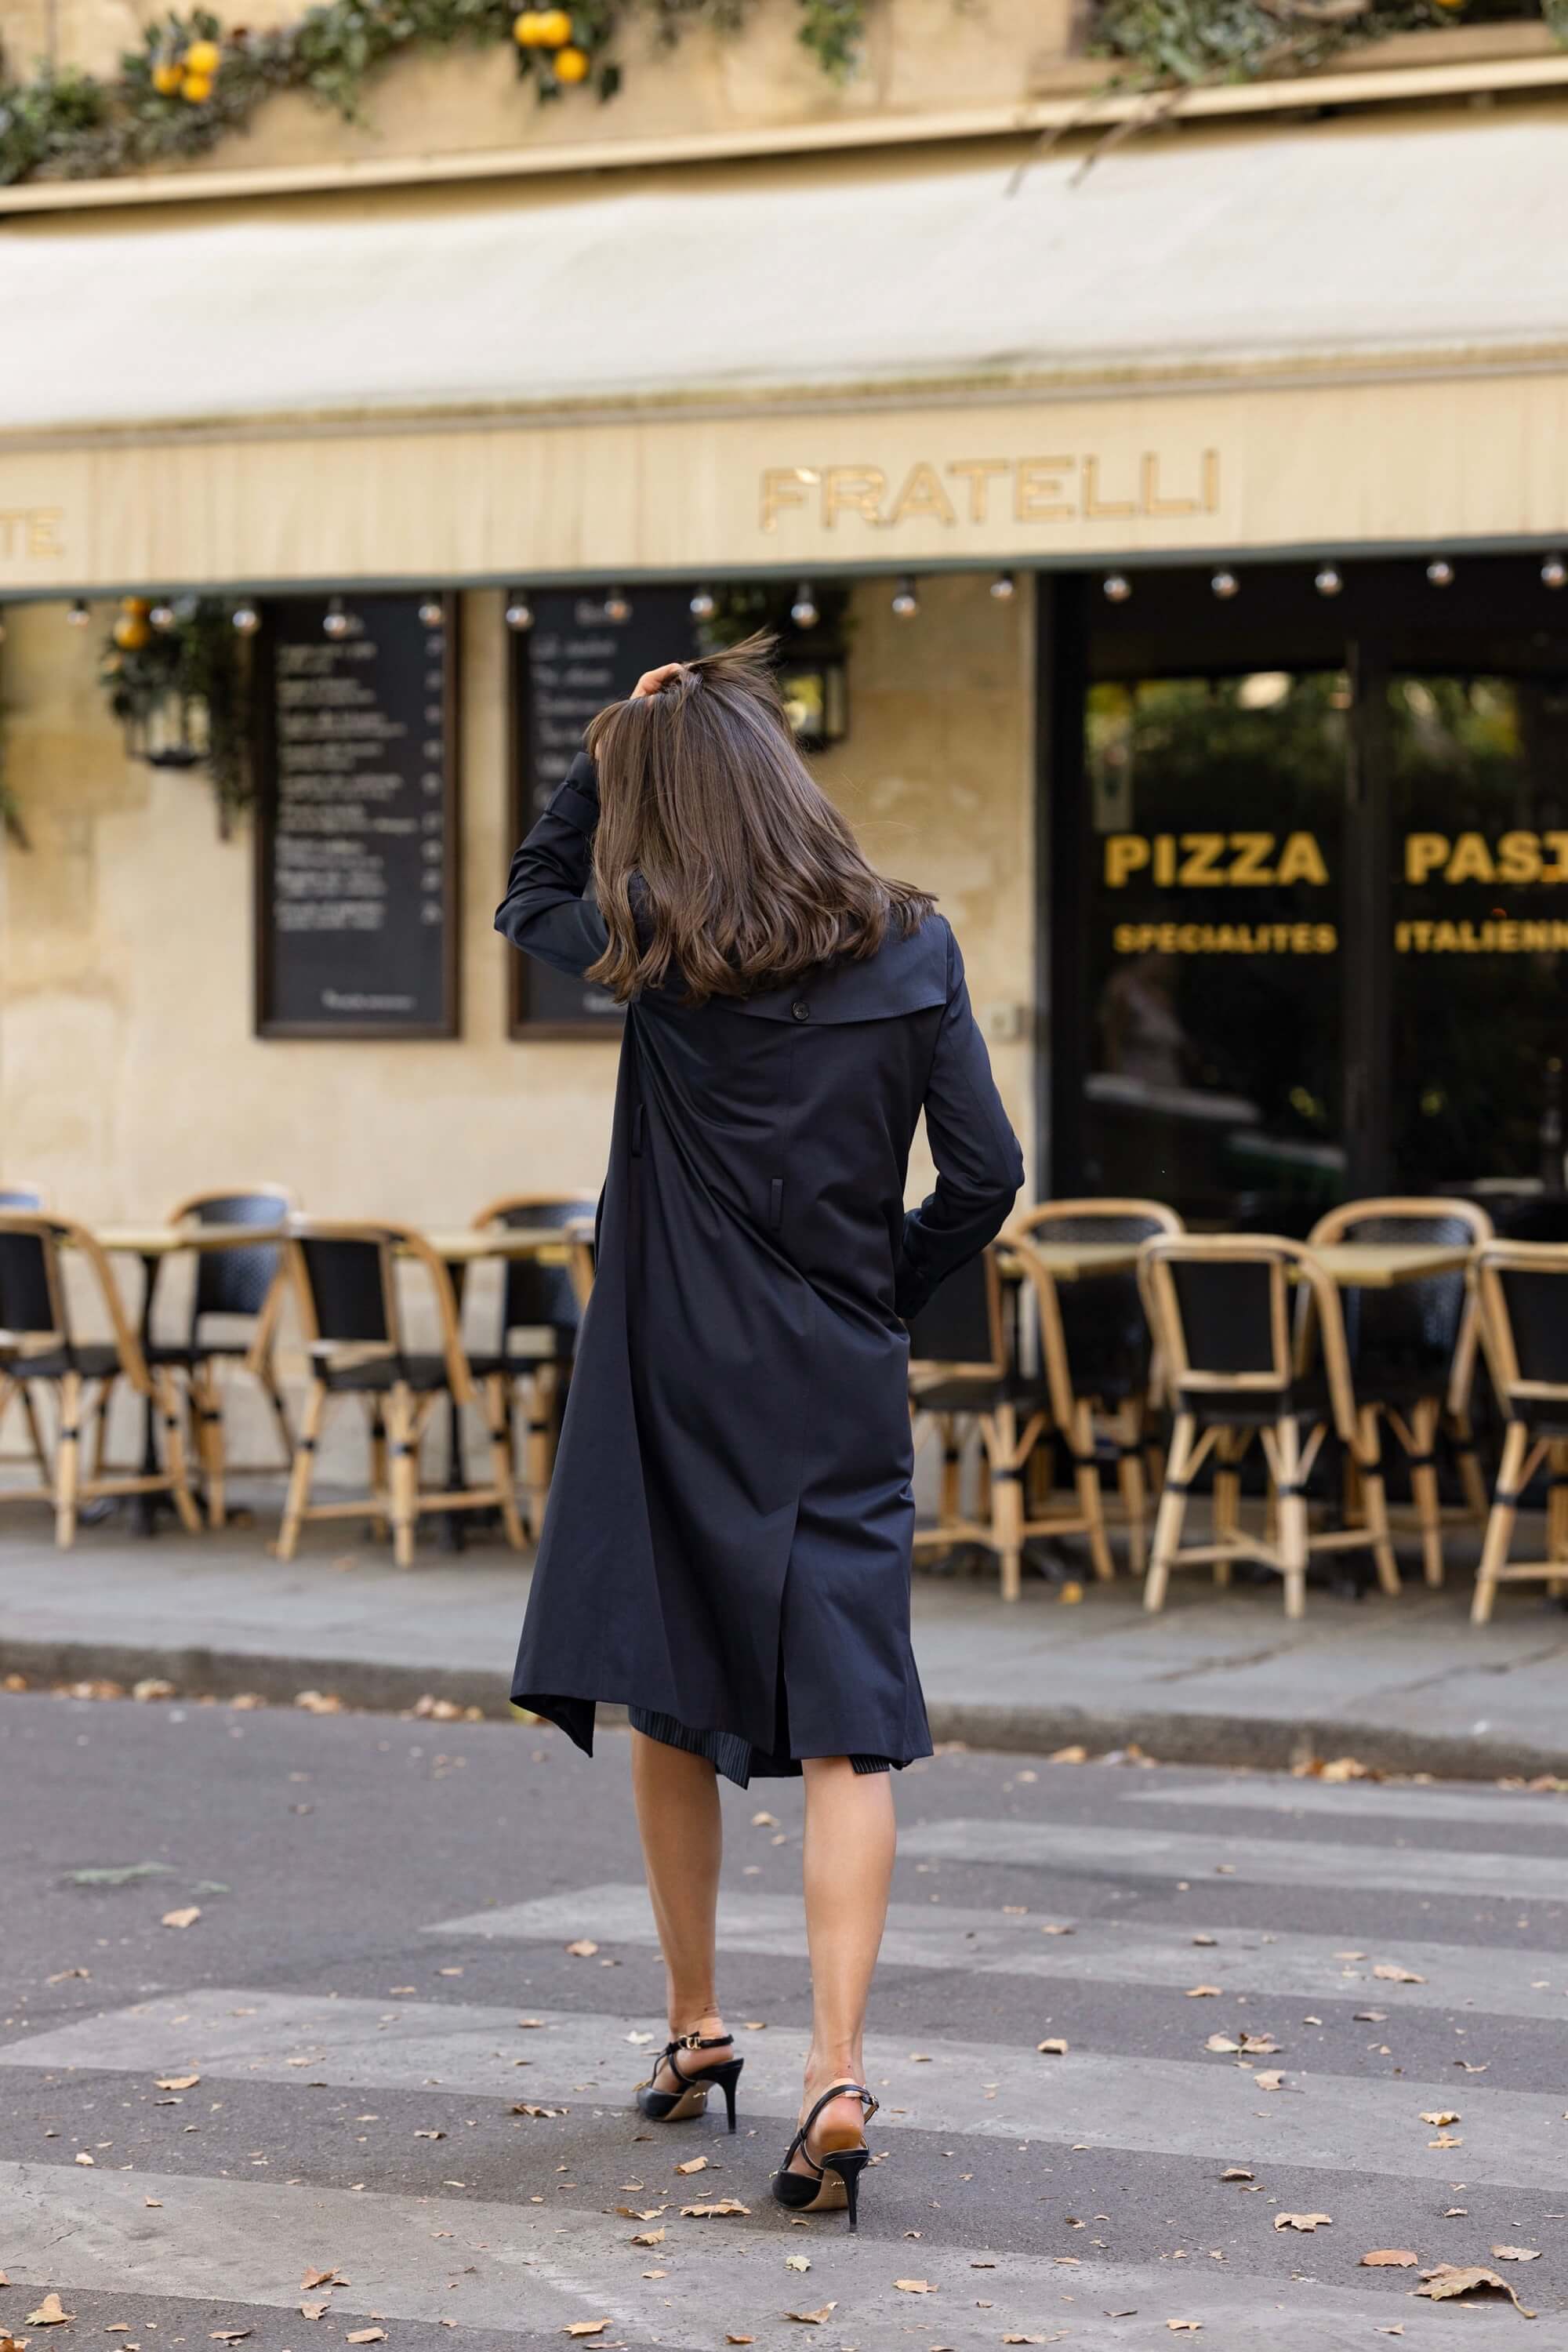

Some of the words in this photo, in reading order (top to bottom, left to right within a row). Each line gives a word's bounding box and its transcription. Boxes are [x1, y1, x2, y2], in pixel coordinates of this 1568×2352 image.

[761, 449, 1219, 532] FRATELLI
[1105, 832, 1327, 886] PIZZA
[1114, 922, 1337, 953] SPECIALITES
